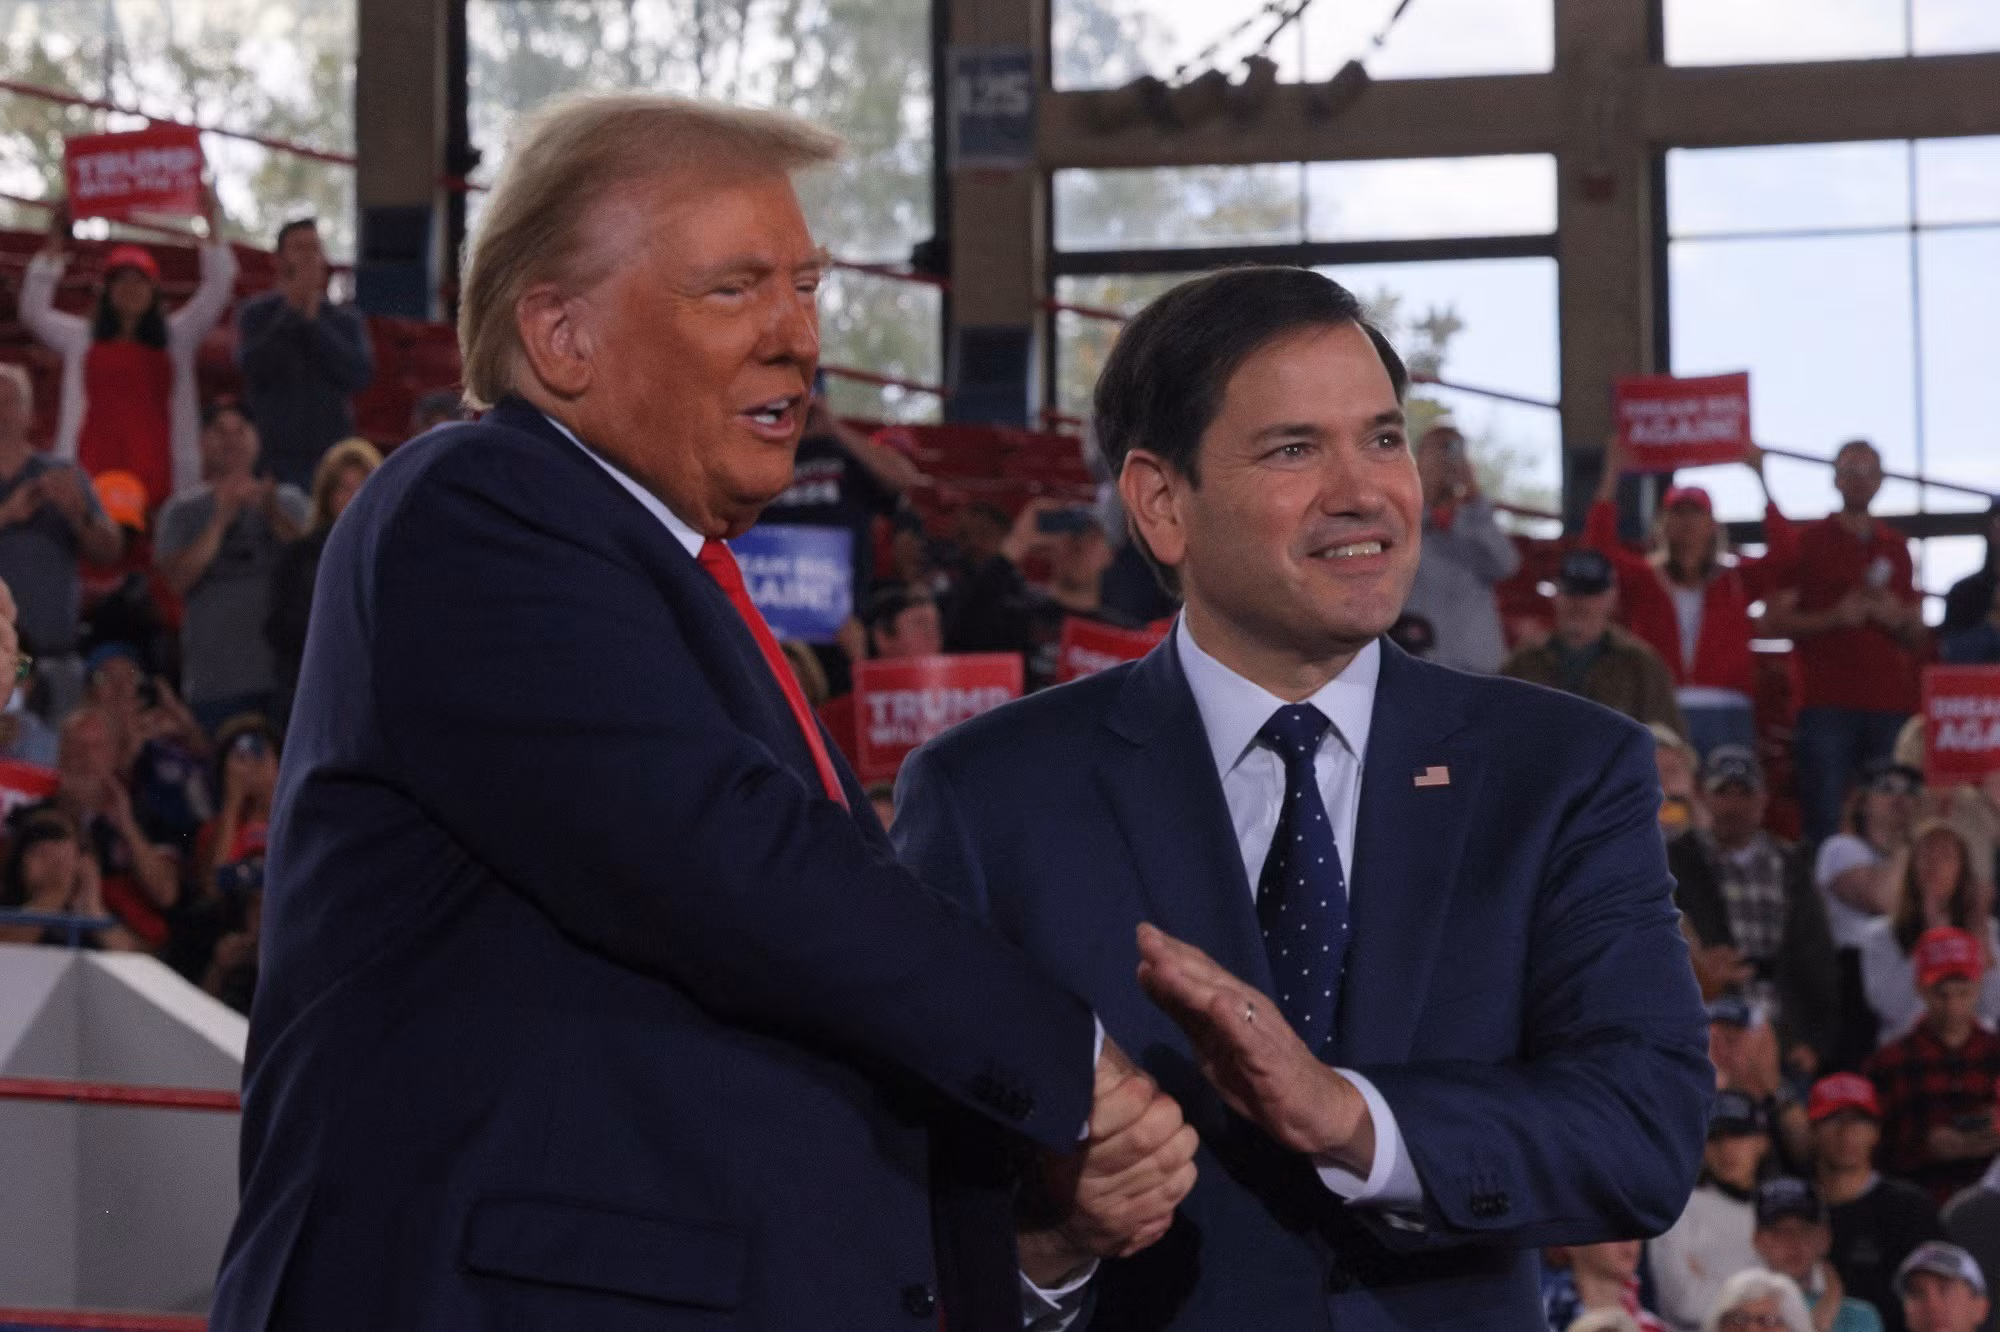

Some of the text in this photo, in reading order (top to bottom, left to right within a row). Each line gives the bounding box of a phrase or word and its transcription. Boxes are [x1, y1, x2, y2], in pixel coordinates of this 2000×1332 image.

[76, 148, 197, 180] TRUMP
[865, 686, 1011, 724] TRUMP
[1932, 697, 2000, 719] DREA
